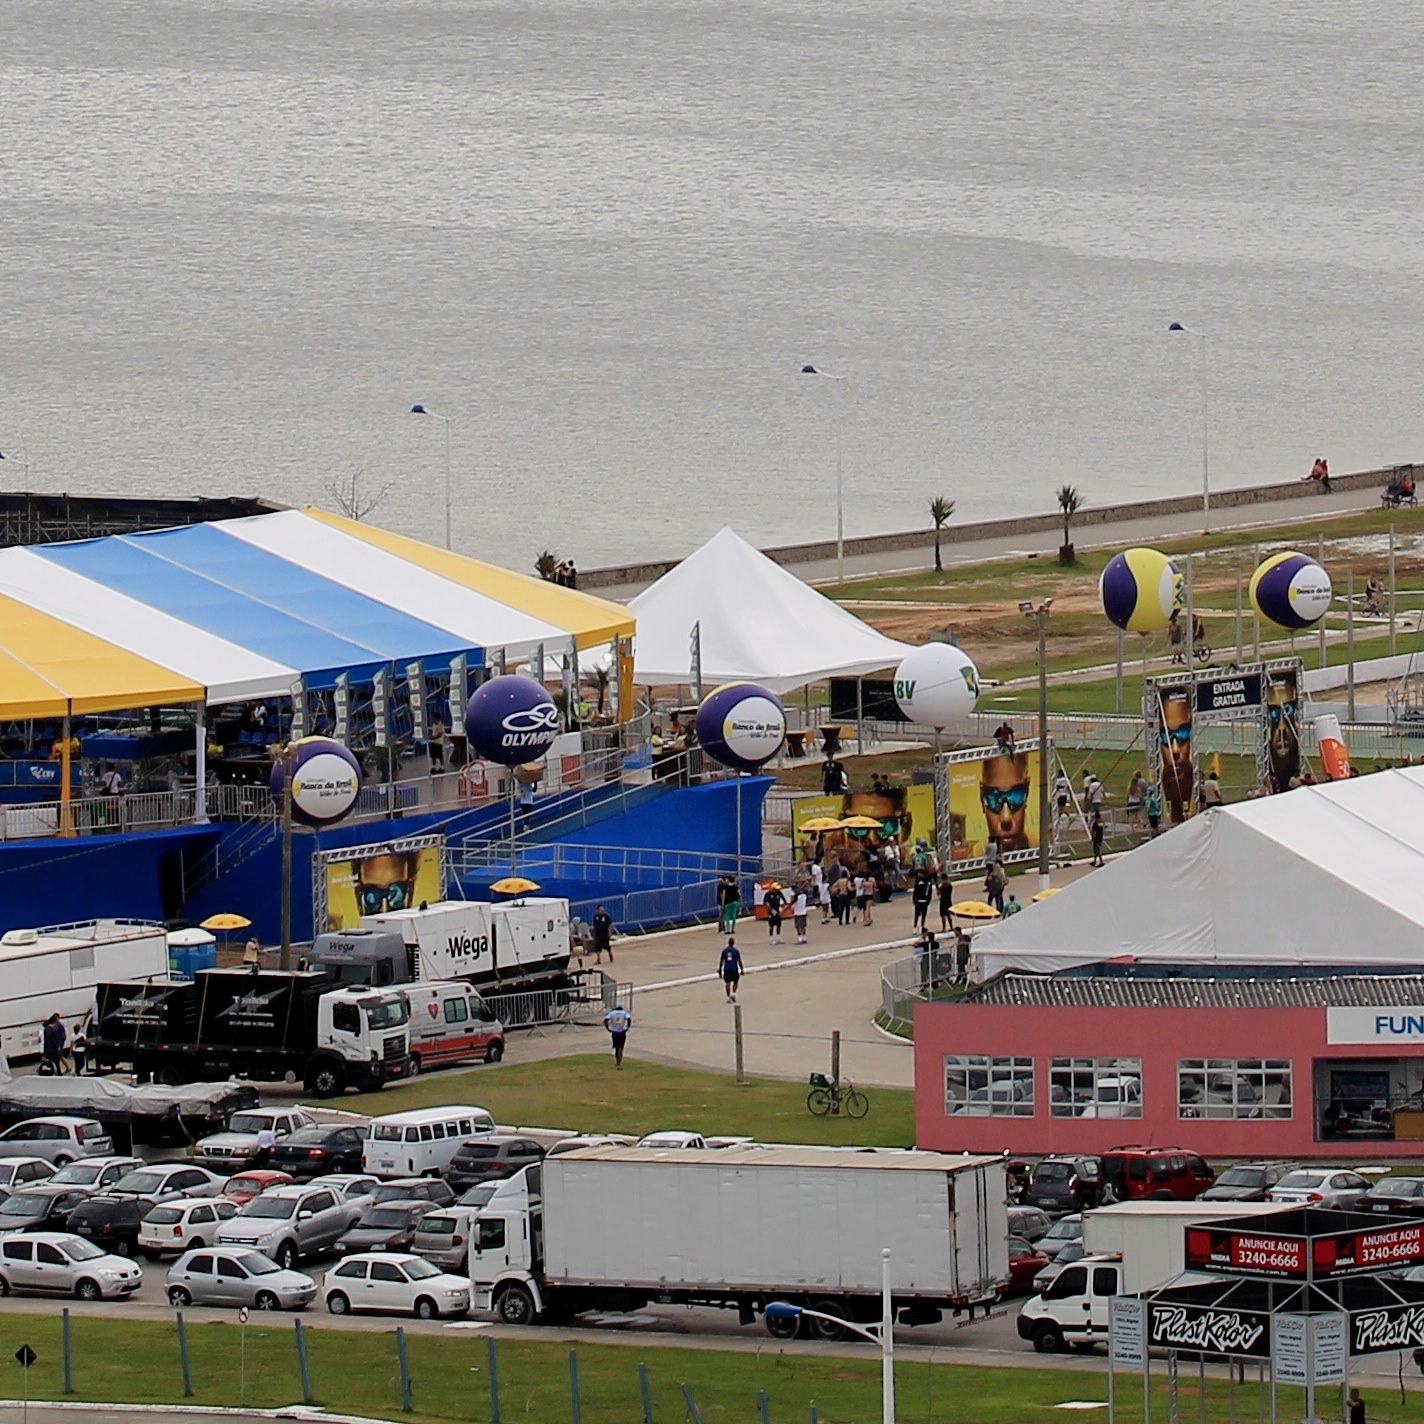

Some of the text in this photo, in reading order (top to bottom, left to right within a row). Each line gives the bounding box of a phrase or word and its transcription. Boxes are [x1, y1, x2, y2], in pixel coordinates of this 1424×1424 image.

[895, 679, 916, 700] BV
[1213, 680, 1245, 695] ENTRADA
[1212, 693, 1246, 708] GRATUITA
[329, 941, 355, 952] Wega
[448, 935, 488, 960] Wega
[1238, 1237, 1298, 1253] ANUNCIE AQUI
[1362, 1229, 1421, 1247] ANUNCIE AQUI
[1238, 1250, 1298, 1268] 3240-6666
[1362, 1241, 1421, 1262] 3240-6666
[1153, 1307, 1264, 1352] PlastKolor
